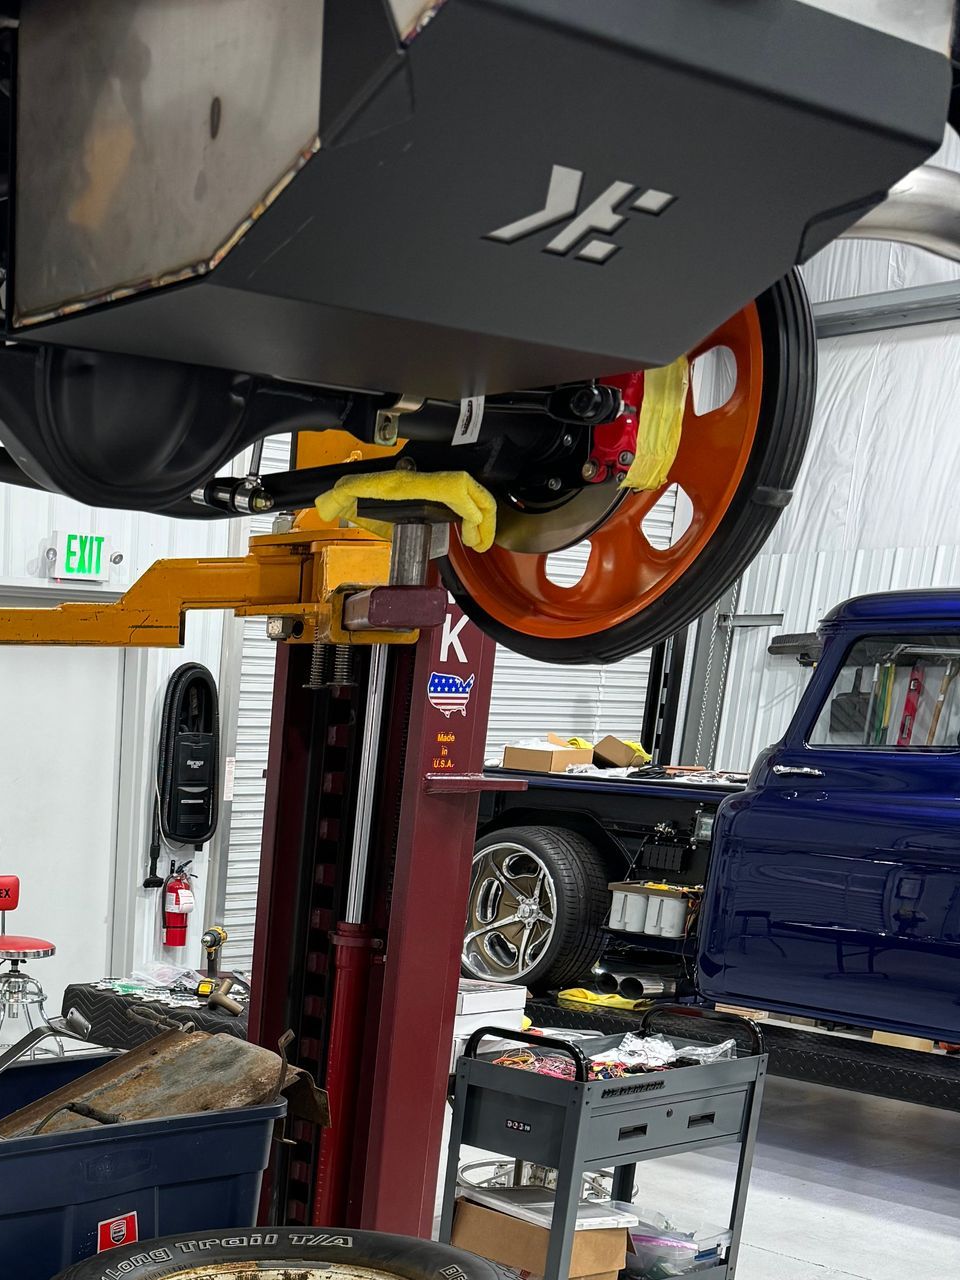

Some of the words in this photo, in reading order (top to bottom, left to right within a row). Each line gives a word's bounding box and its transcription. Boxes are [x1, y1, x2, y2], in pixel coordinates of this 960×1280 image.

[65, 534, 105, 574] EXIT
[437, 733, 456, 742] Made
[441, 746, 448, 756] in
[105, 1246, 173, 1280] Long
[175, 1233, 279, 1253] Trail
[289, 1233, 353, 1248] T/A
